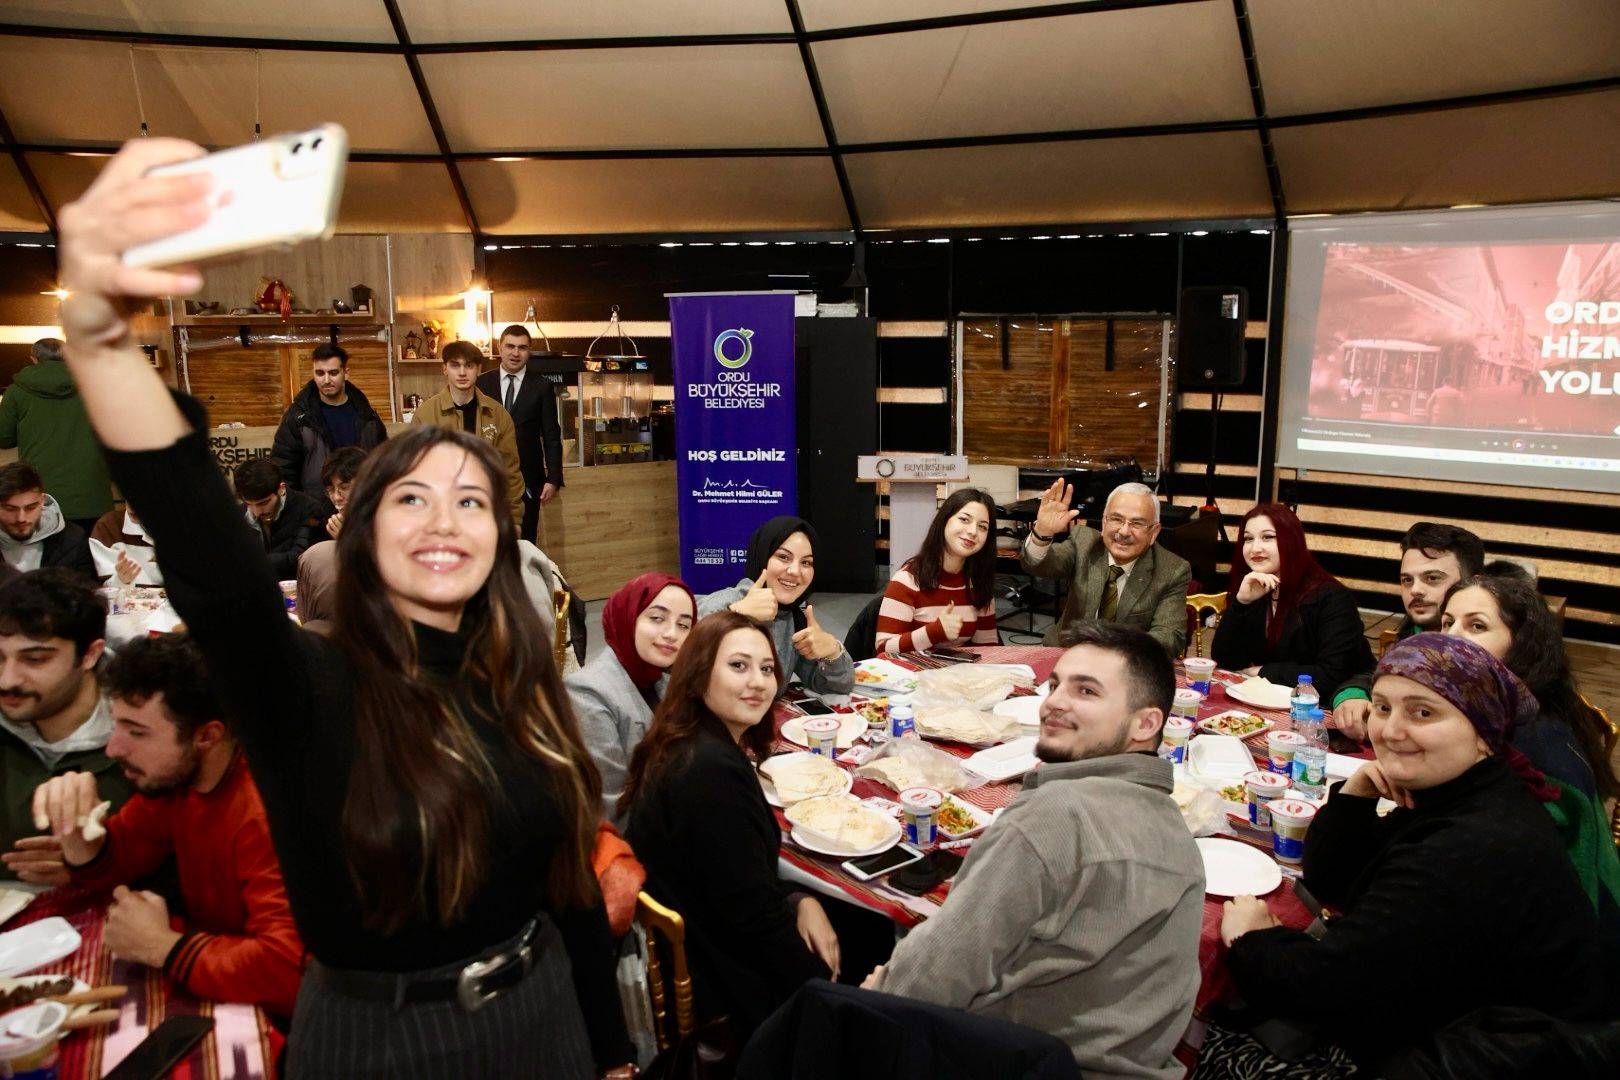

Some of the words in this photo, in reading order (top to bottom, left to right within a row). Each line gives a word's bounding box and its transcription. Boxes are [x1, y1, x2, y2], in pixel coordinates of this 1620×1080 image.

[718, 372, 750, 382] ORDU
[1539, 369, 1620, 395] YOL
[688, 383, 781, 398] BÜYÜKŞEHİR
[705, 398, 765, 409] BELEDİYESİ
[209, 436, 238, 448] RDU
[688, 450, 717, 463] HOŞ
[720, 448, 785, 462] GELDİNİZ
[757, 489, 783, 498] GÜLER
